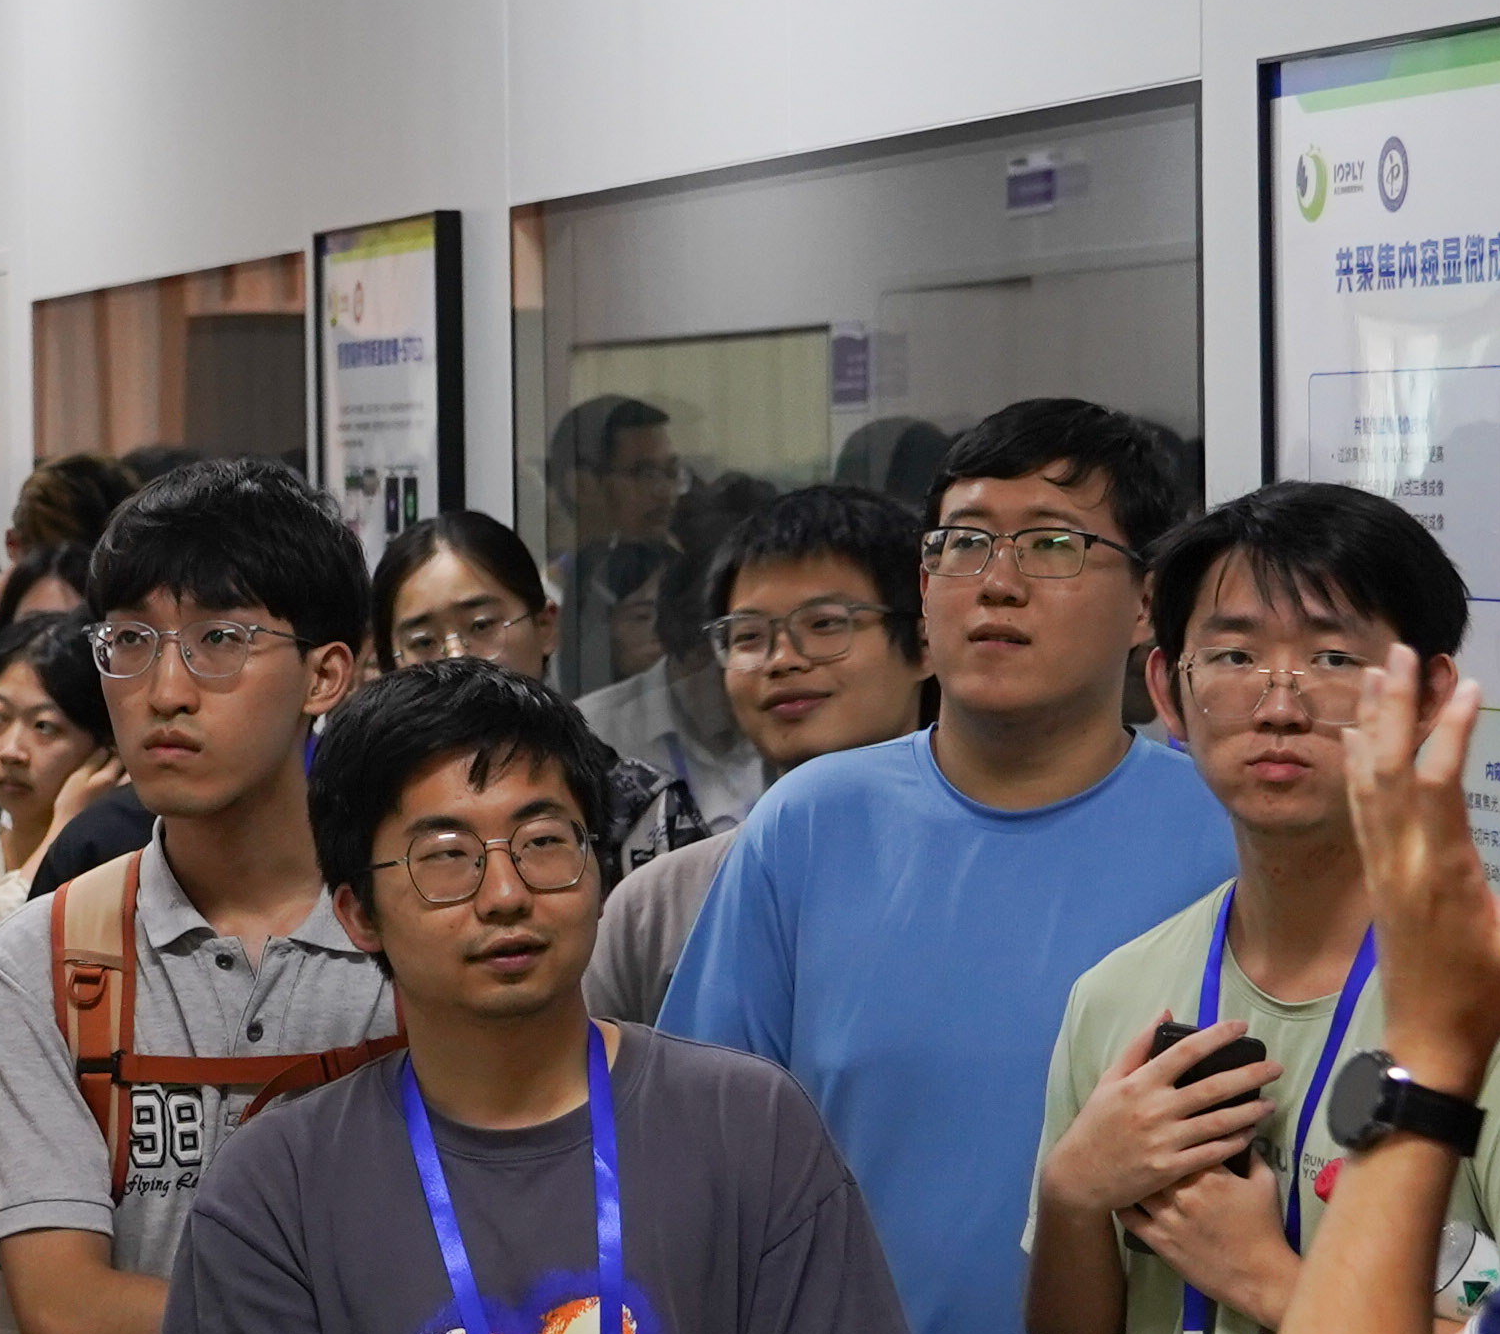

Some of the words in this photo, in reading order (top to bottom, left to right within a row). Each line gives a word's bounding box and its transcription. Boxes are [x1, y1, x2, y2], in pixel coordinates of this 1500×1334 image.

[130, 1088, 204, 1168] 98
[1303, 1153, 1325, 1168] RUN
[1303, 1167, 1320, 1181] YO
